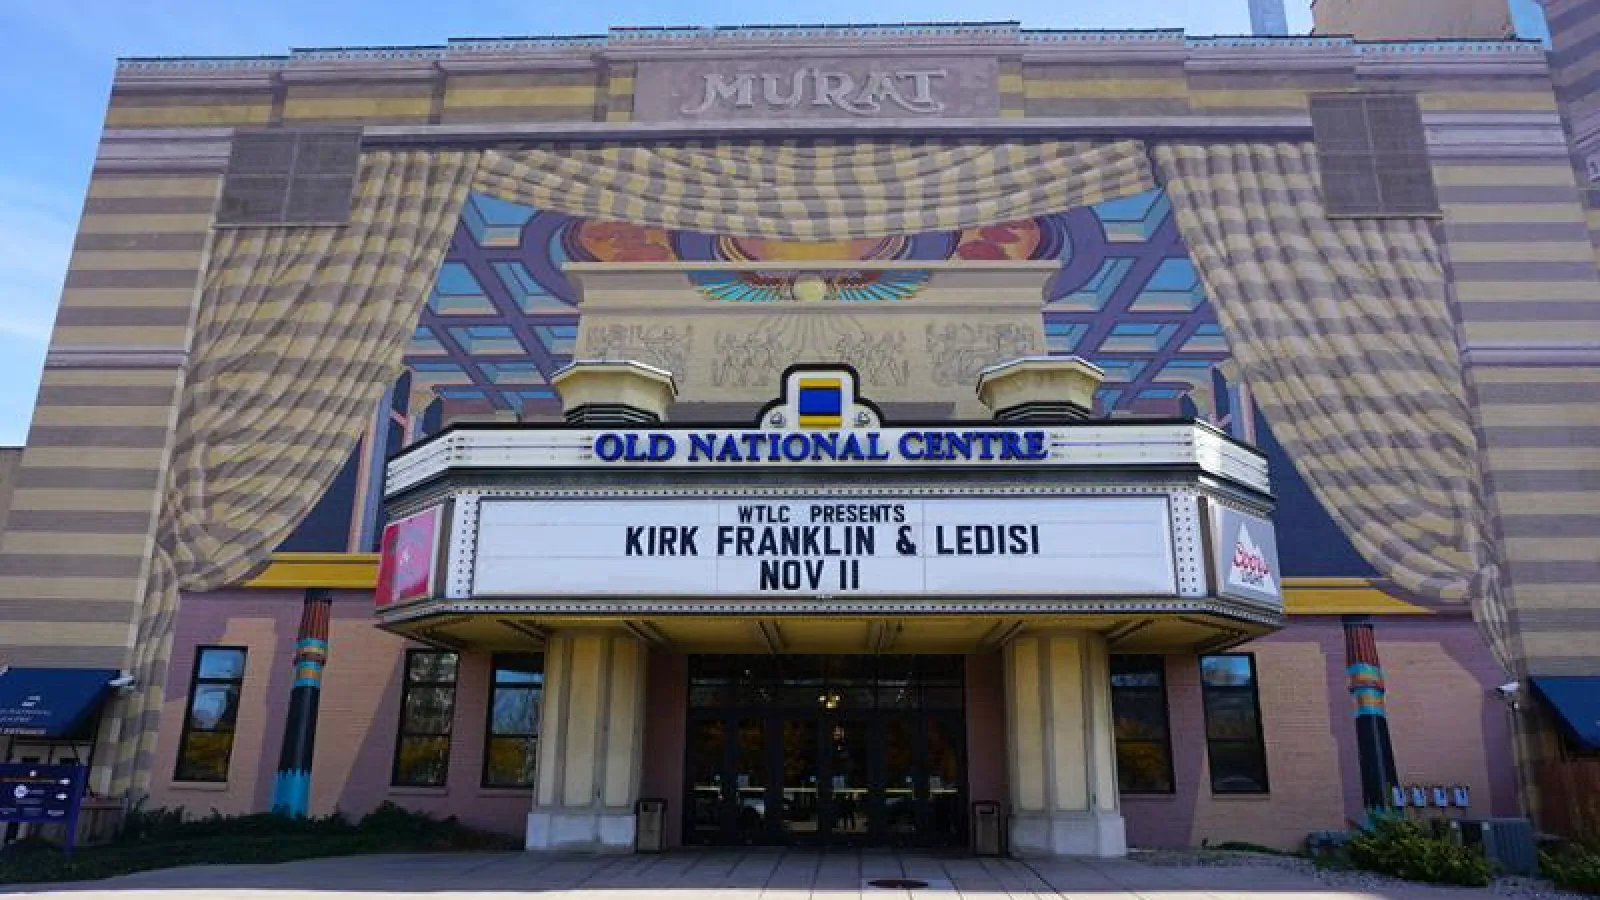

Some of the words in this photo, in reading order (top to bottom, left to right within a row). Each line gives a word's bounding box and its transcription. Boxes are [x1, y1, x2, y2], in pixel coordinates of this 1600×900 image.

[681, 67, 947, 114] MURAT
[594, 433, 677, 462] OLD
[688, 432, 890, 462] NATIONAL
[898, 431, 1049, 461] CENTRE
[738, 504, 790, 523] WTLC
[810, 504, 905, 523] PRESENTS
[626, 525, 699, 557] KIRK
[717, 525, 875, 557] FRANKLIN
[896, 525, 917, 556] &
[936, 525, 1040, 556] LEDISI
[760, 559, 825, 591] NOV
